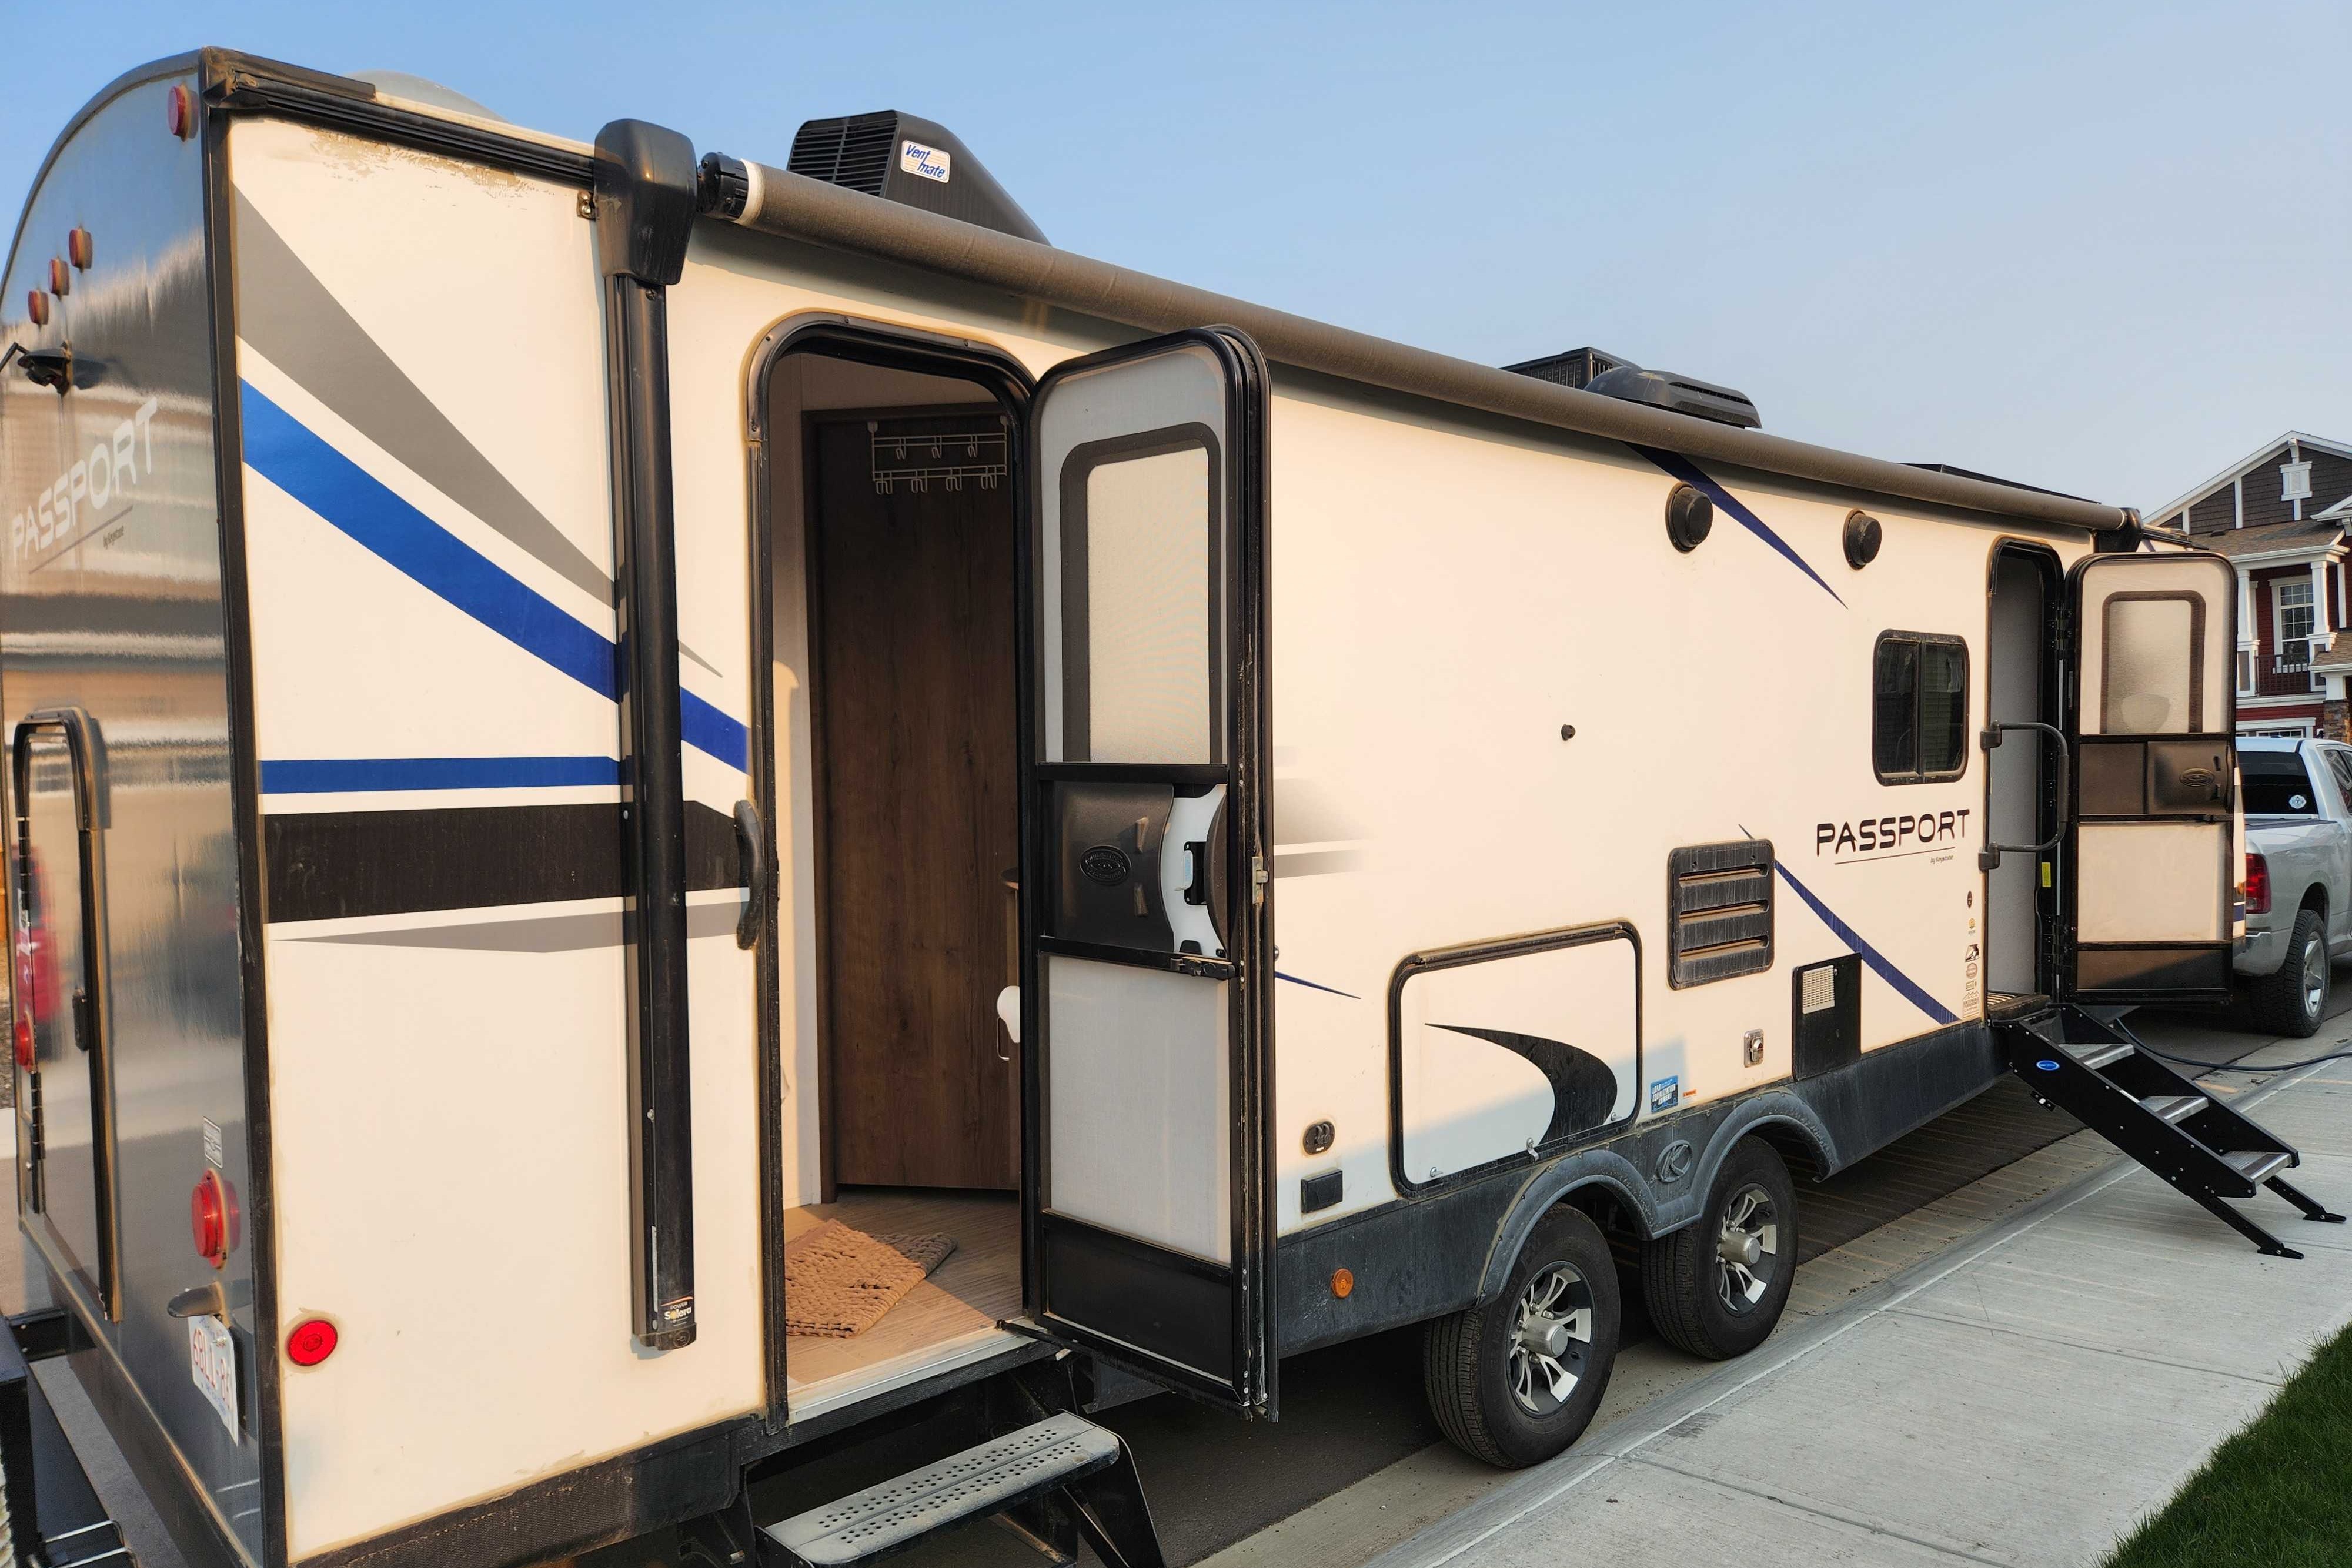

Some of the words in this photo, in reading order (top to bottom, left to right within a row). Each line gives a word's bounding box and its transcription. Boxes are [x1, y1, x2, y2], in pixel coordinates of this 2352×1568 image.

[906, 144, 931, 162] Vent
[917, 162, 946, 178] mate
[12, 396, 158, 567] PASSPORT
[1816, 808, 1970, 857] PASSPORT
[664, 1306, 692, 1320] Solera
